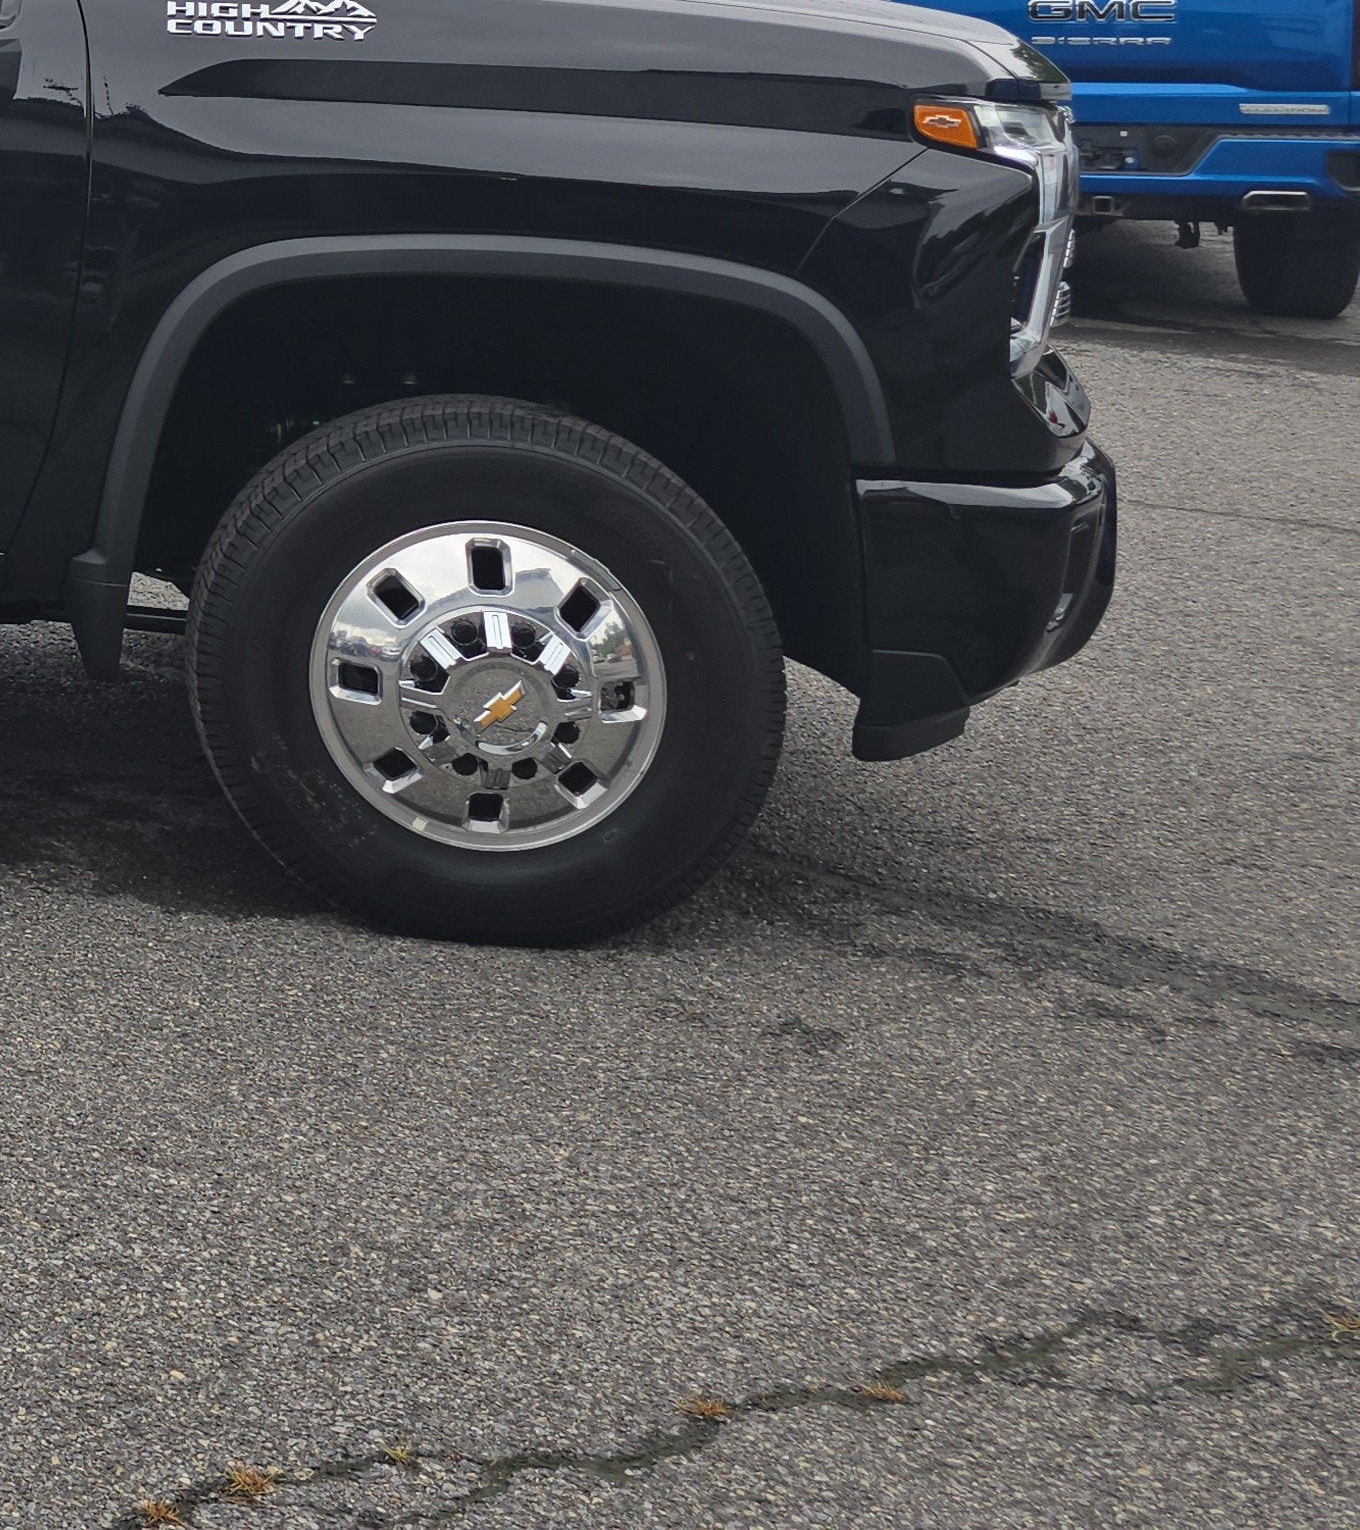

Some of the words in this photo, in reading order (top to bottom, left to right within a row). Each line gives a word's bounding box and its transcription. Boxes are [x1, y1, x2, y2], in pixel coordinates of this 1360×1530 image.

[166, 1, 270, 19] HIGH
[1028, 0, 1177, 23] GMC
[166, 19, 376, 41] COUNTRY
[1031, 37, 1172, 46] SIERRA
